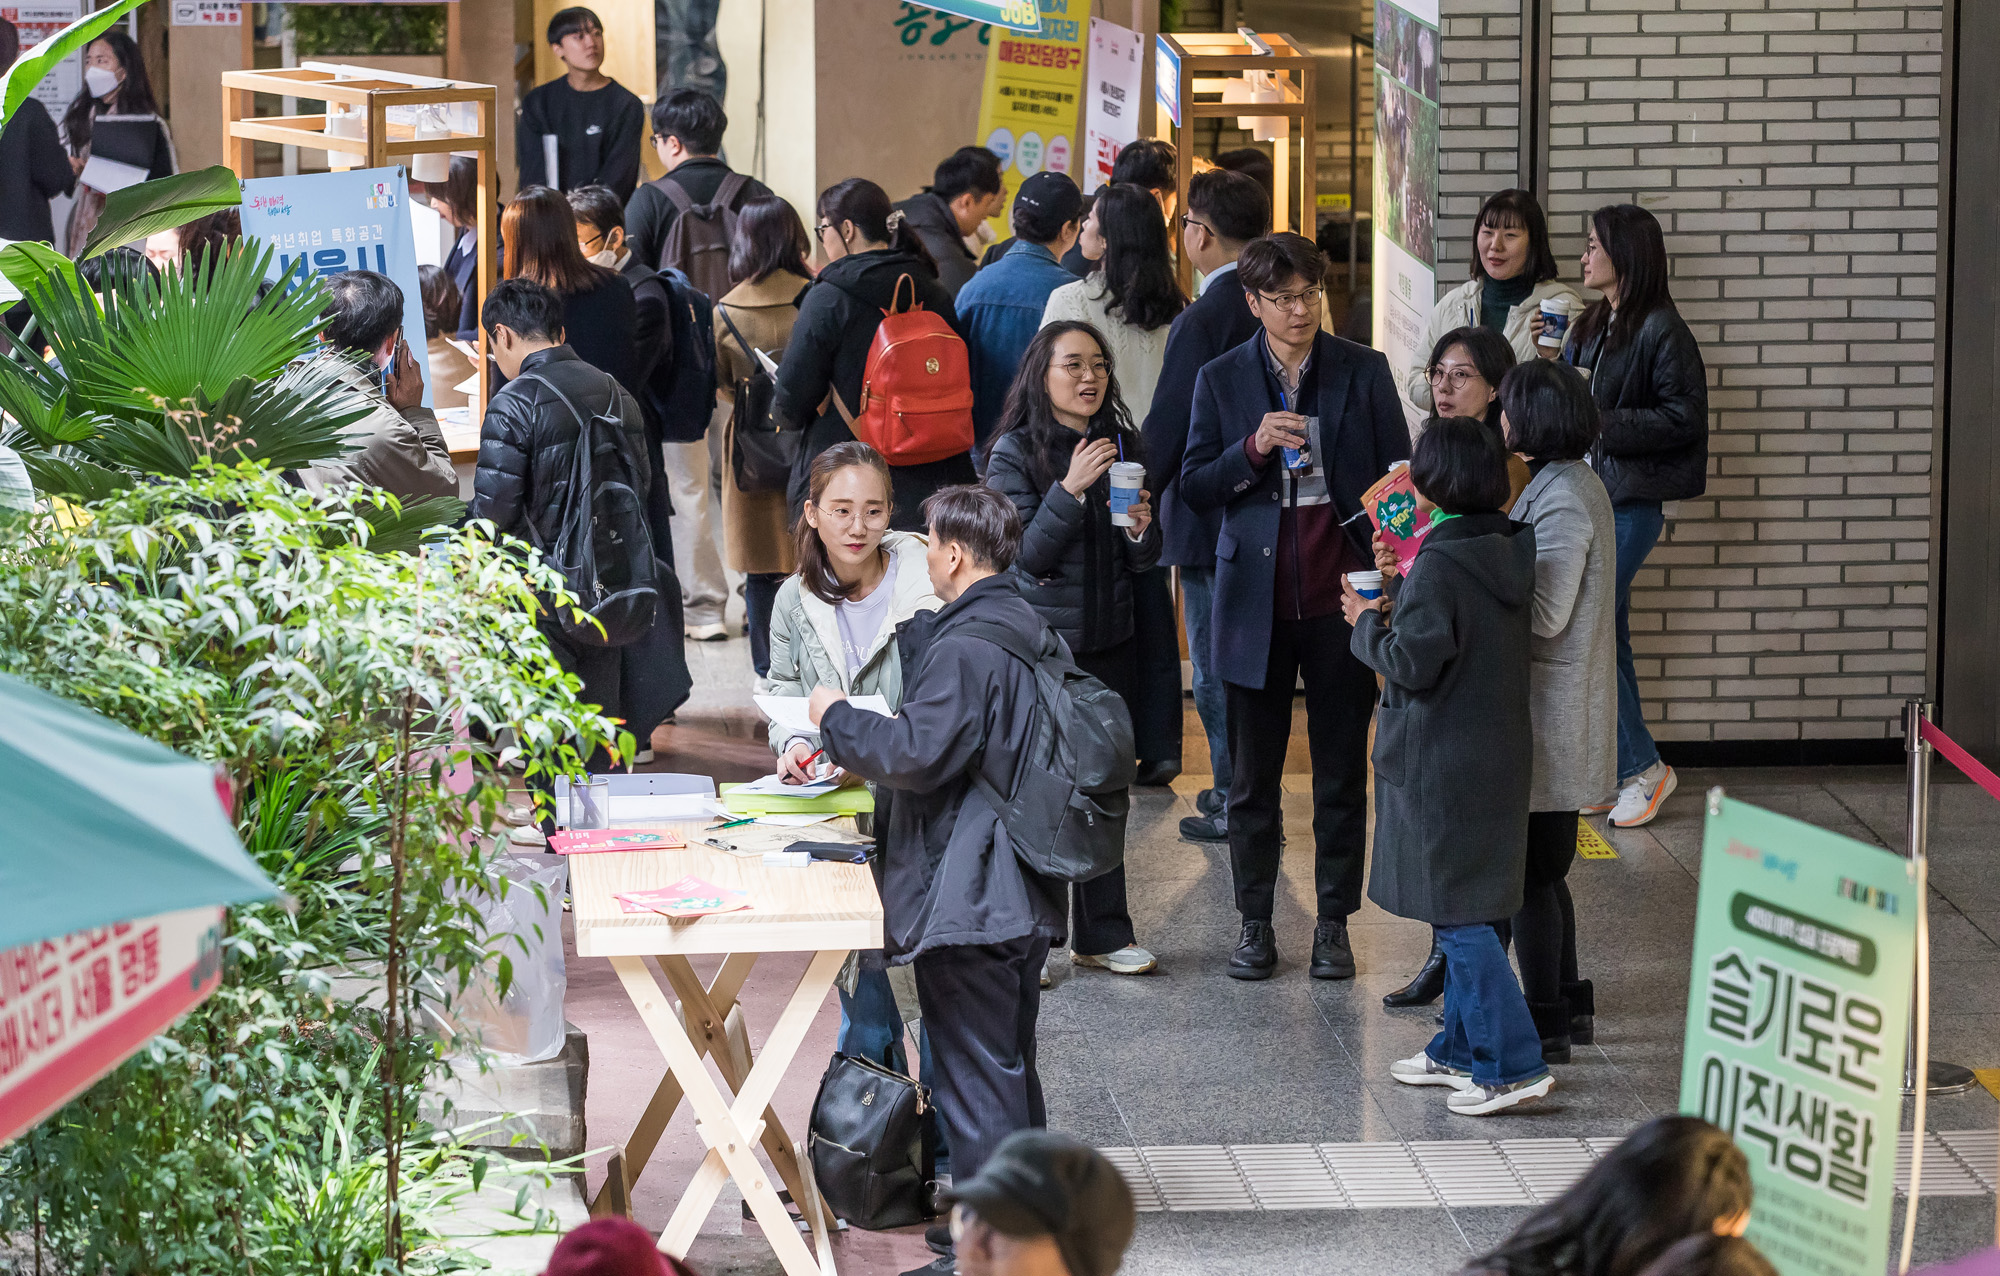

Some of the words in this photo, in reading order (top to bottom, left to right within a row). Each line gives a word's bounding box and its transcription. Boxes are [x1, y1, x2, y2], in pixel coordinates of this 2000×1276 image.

[270, 230, 323, 250] 청년취업
[331, 224, 383, 243] 특화공간
[117, 924, 160, 998] 명동
[1707, 950, 1884, 1095] 슬기로운
[1701, 1054, 1876, 1203] 이직생활
